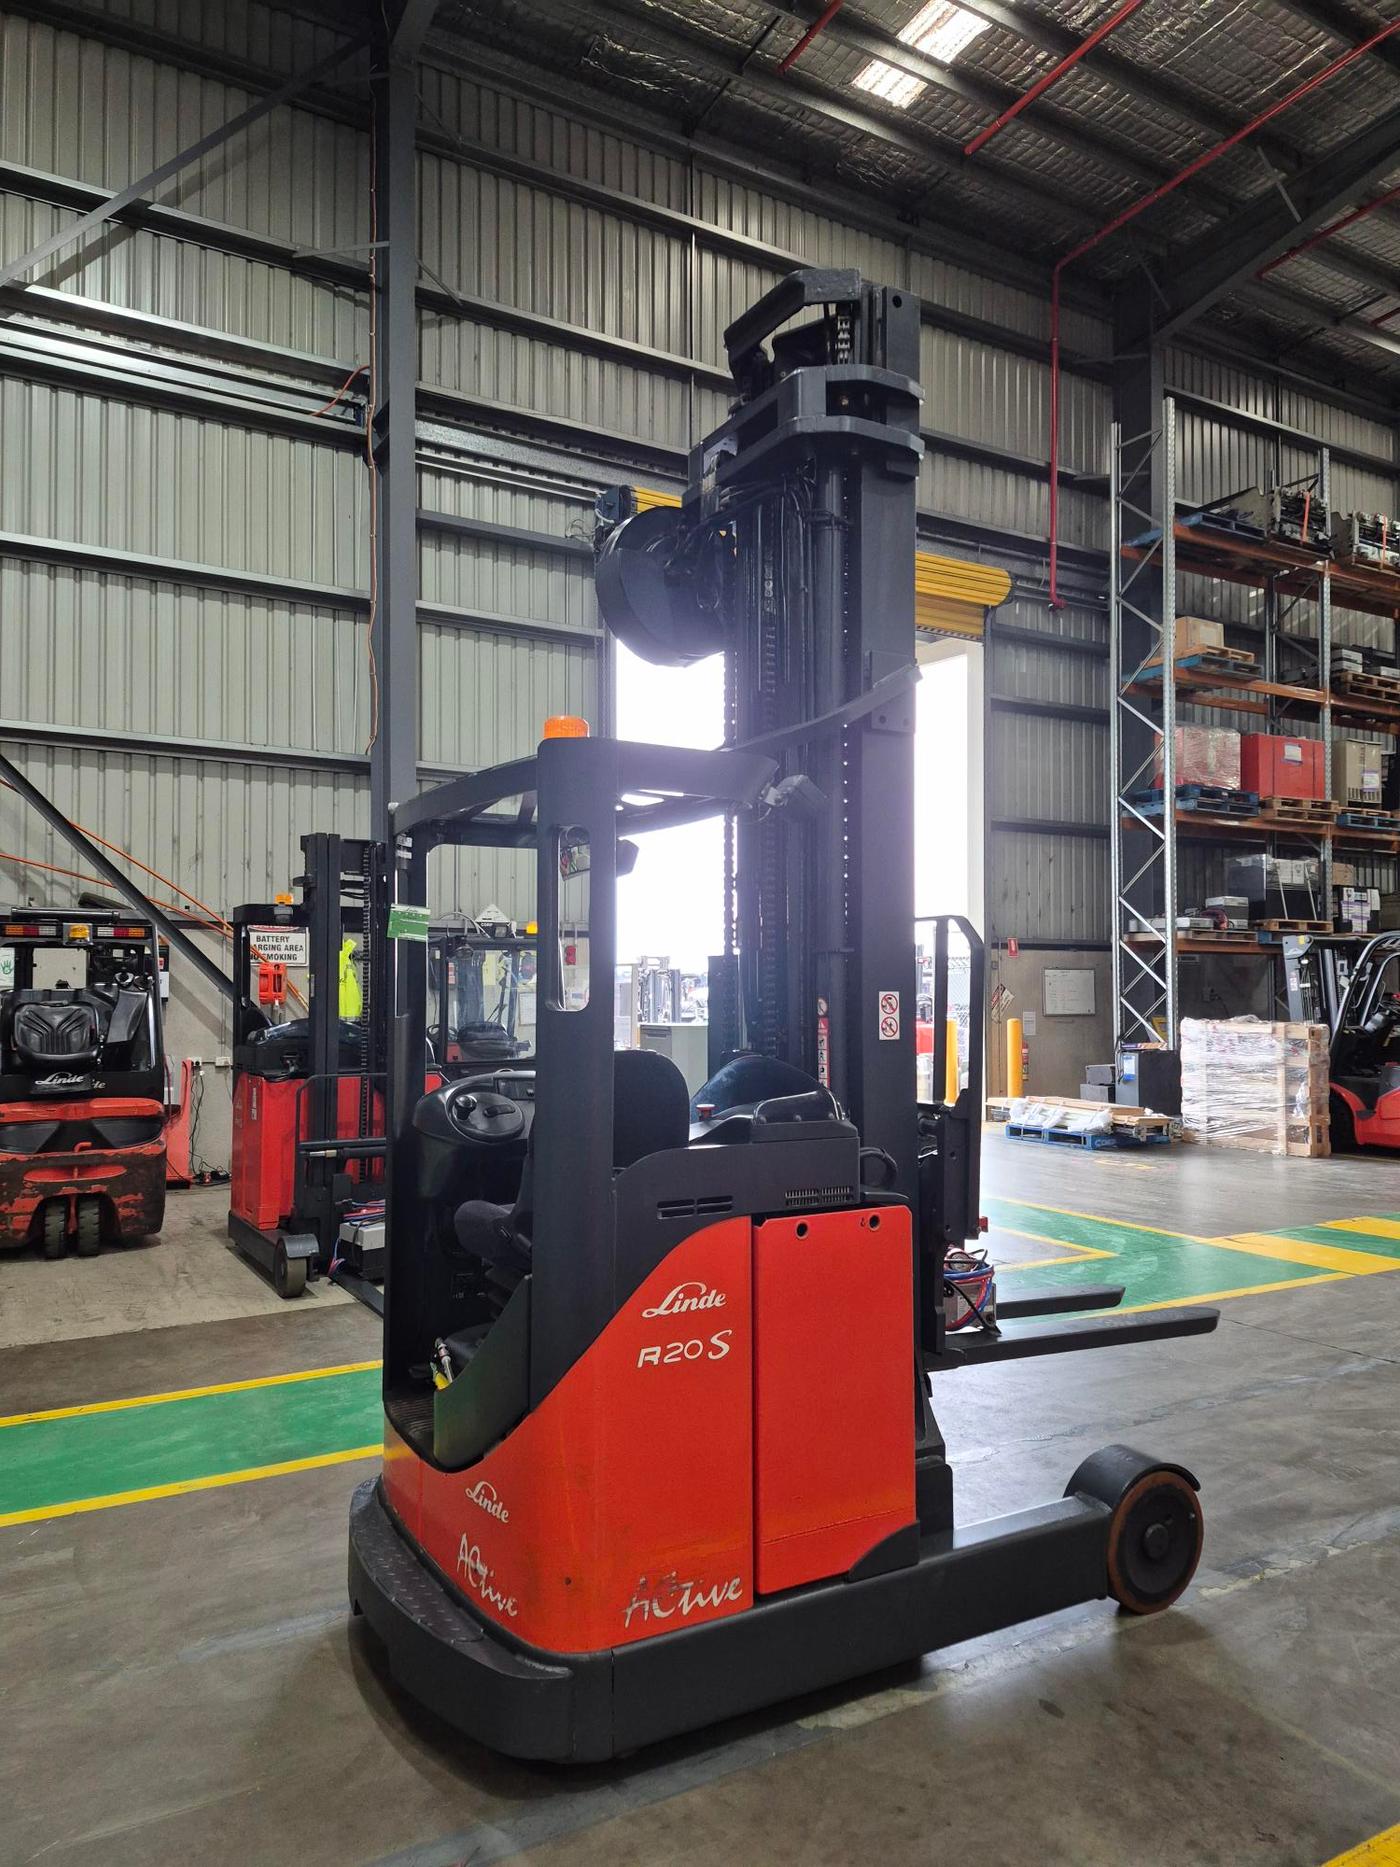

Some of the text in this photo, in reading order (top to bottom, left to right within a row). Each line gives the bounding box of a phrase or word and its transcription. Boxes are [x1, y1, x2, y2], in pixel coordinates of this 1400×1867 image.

[256, 935, 289, 943] BATTERY
[34, 1071, 84, 1085] Linde
[641, 1281, 727, 1318] Linde
[465, 1480, 510, 1524] Linde
